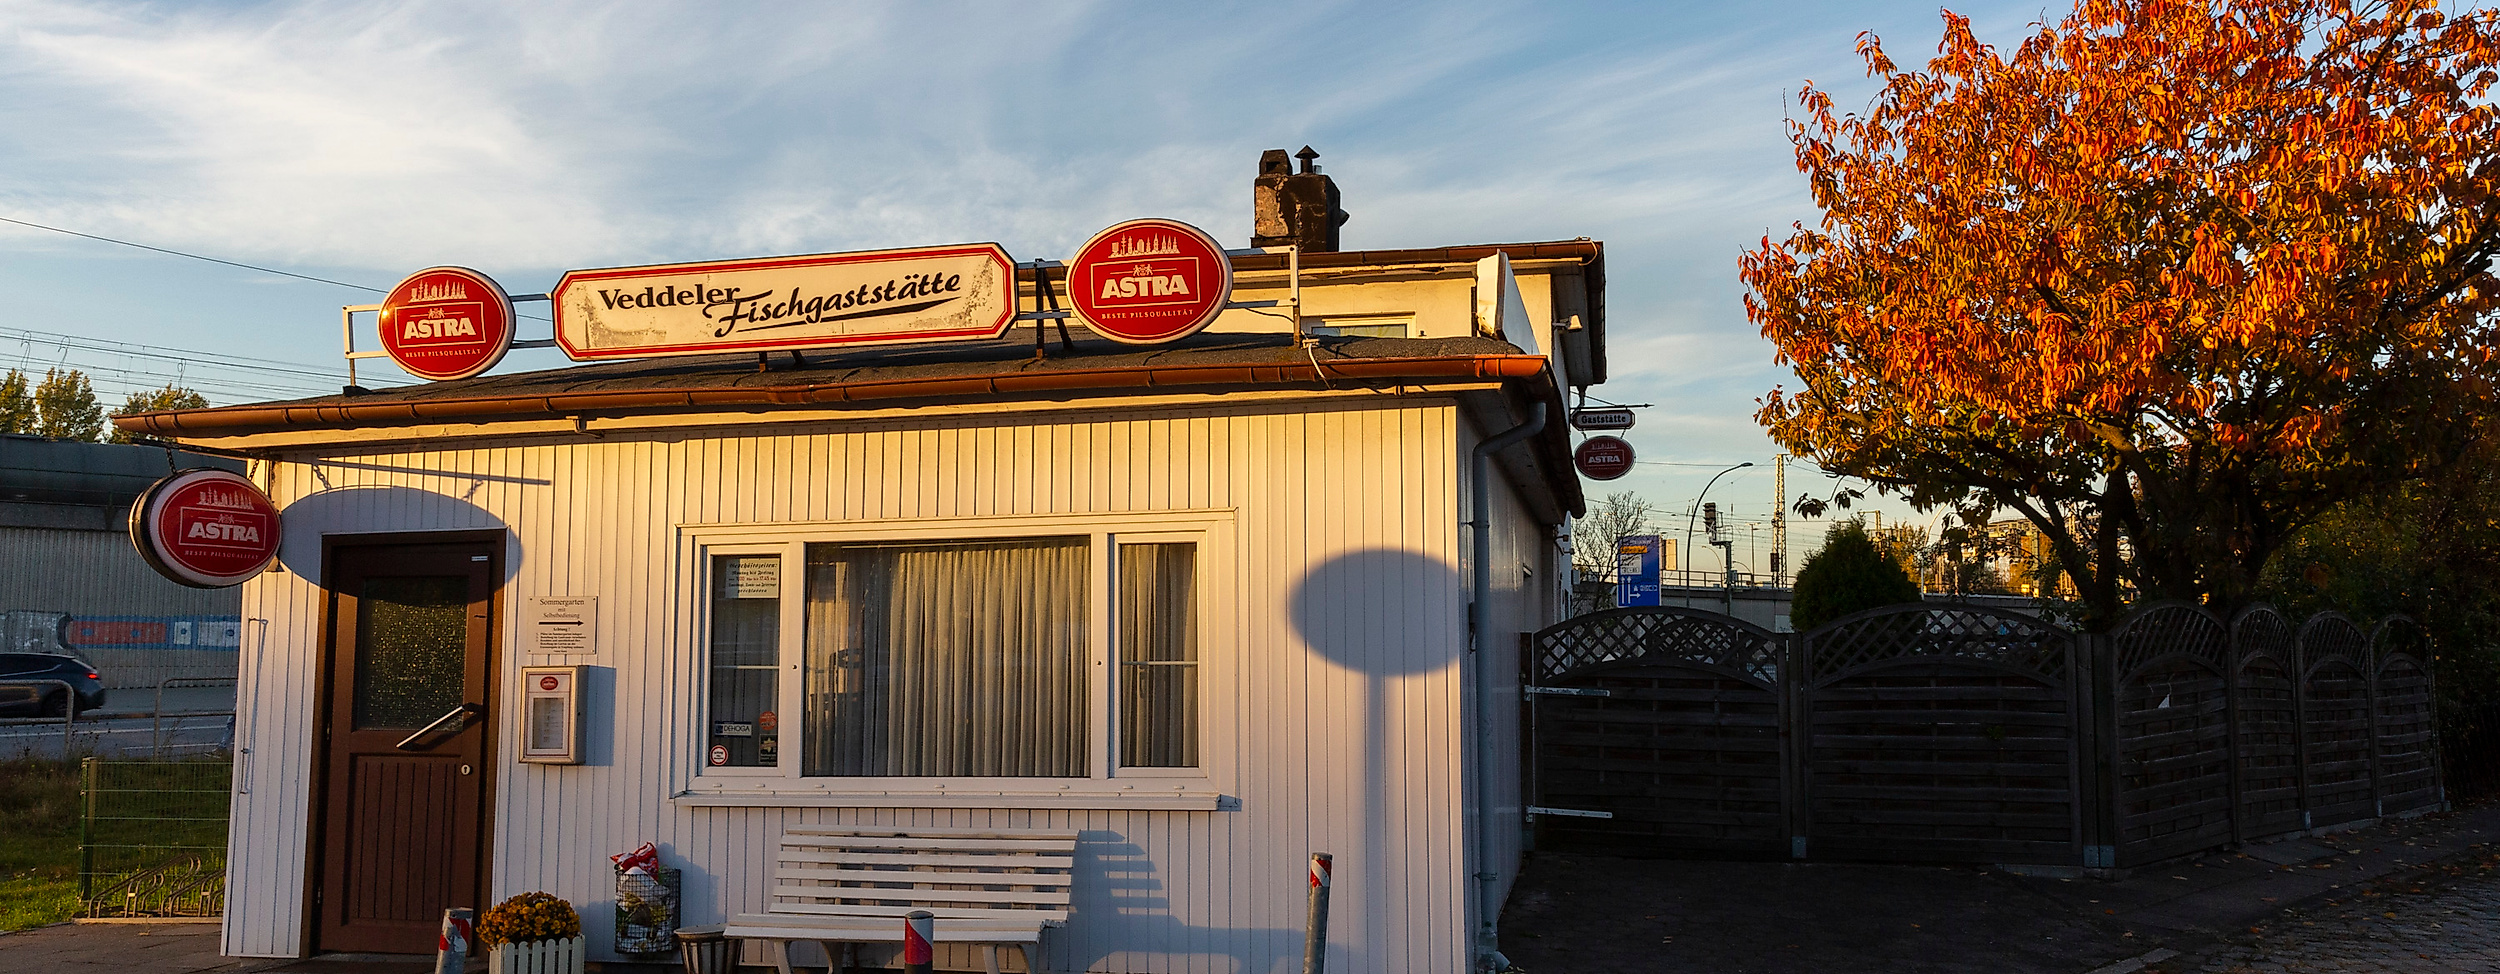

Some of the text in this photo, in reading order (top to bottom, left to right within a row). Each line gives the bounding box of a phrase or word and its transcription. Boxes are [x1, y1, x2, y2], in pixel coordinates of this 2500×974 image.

[1101, 275, 1190, 299] ASTRA
[597, 272, 962, 338] Veddeler Fischgaststätte
[1130, 309, 1194, 319] PILSQUALITÄT
[403, 317, 477, 340] ASTRA
[1581, 415, 1626, 424] Gaststätte
[1588, 455, 1621, 463] ASTRA
[187, 521, 260, 543] ASTRA
[540, 598, 585, 607] Sommergarten
